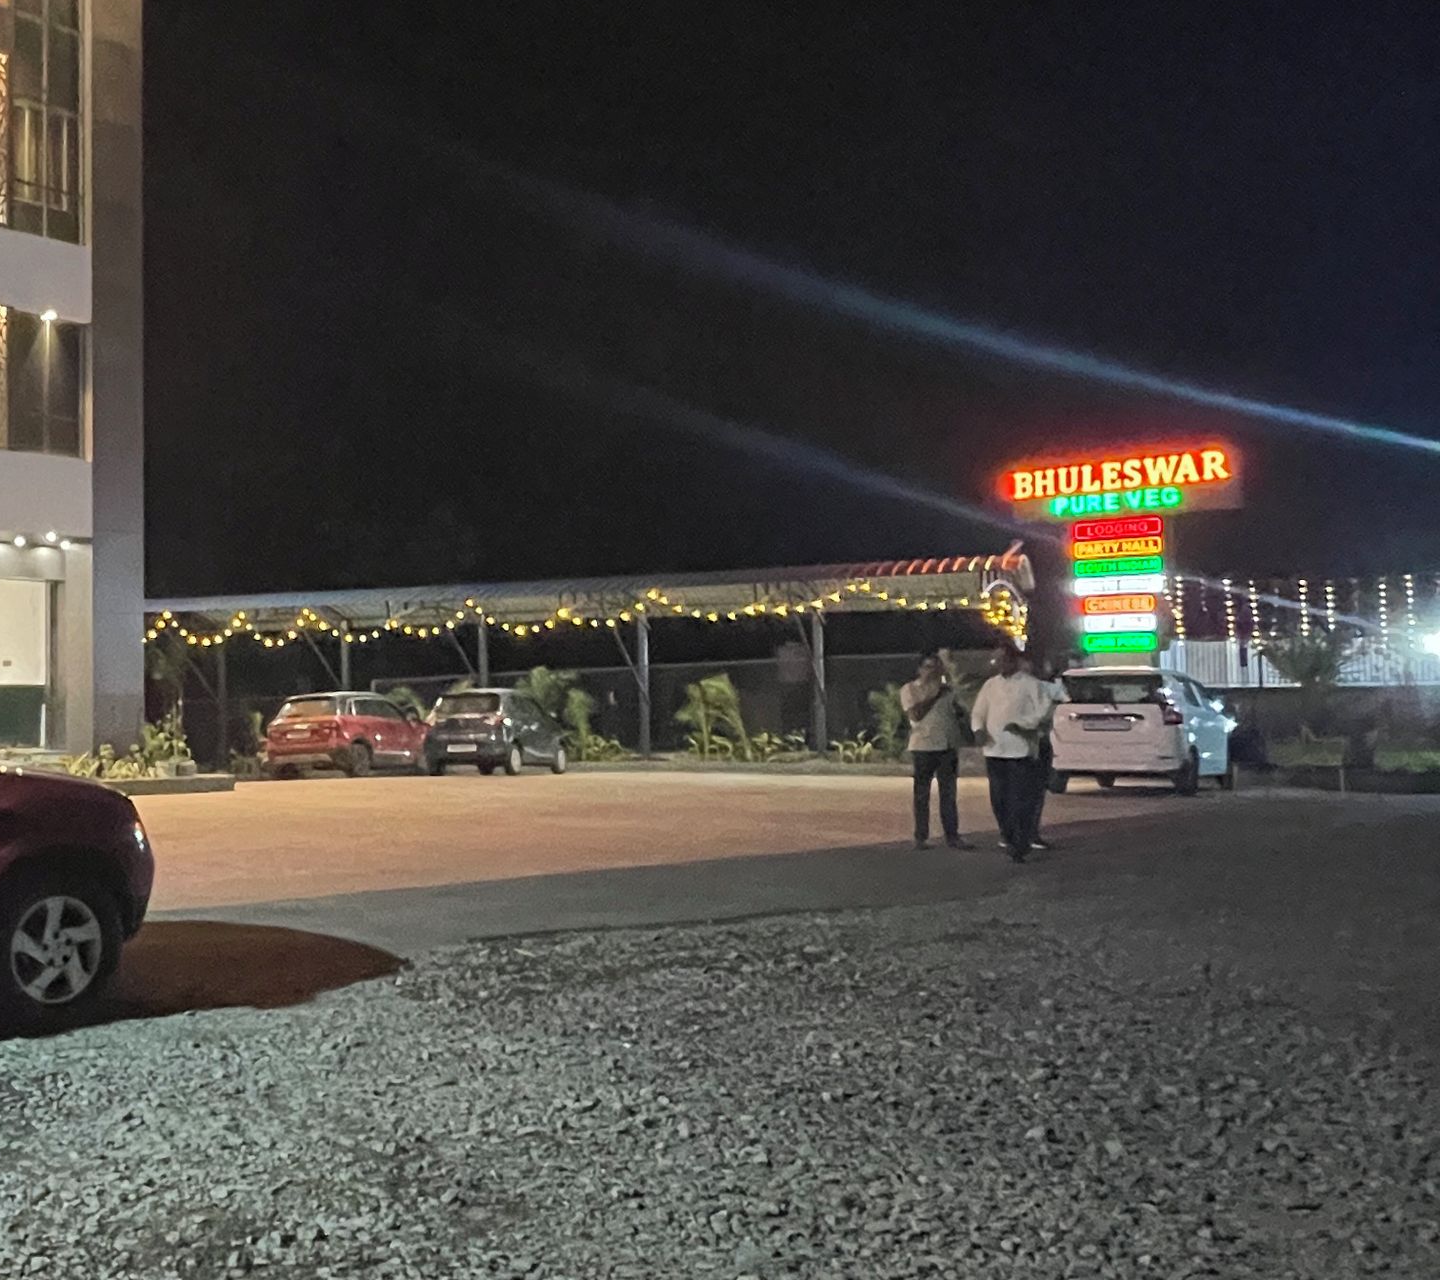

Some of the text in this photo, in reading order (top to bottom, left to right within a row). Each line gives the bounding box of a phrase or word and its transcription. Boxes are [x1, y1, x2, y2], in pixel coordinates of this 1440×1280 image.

[1014, 450, 1230, 499] BHULESWAR
[1052, 486, 1180, 516] PURE VEG
[1087, 522, 1148, 536] LODGING
[1078, 540, 1158, 555] PARTY HALL
